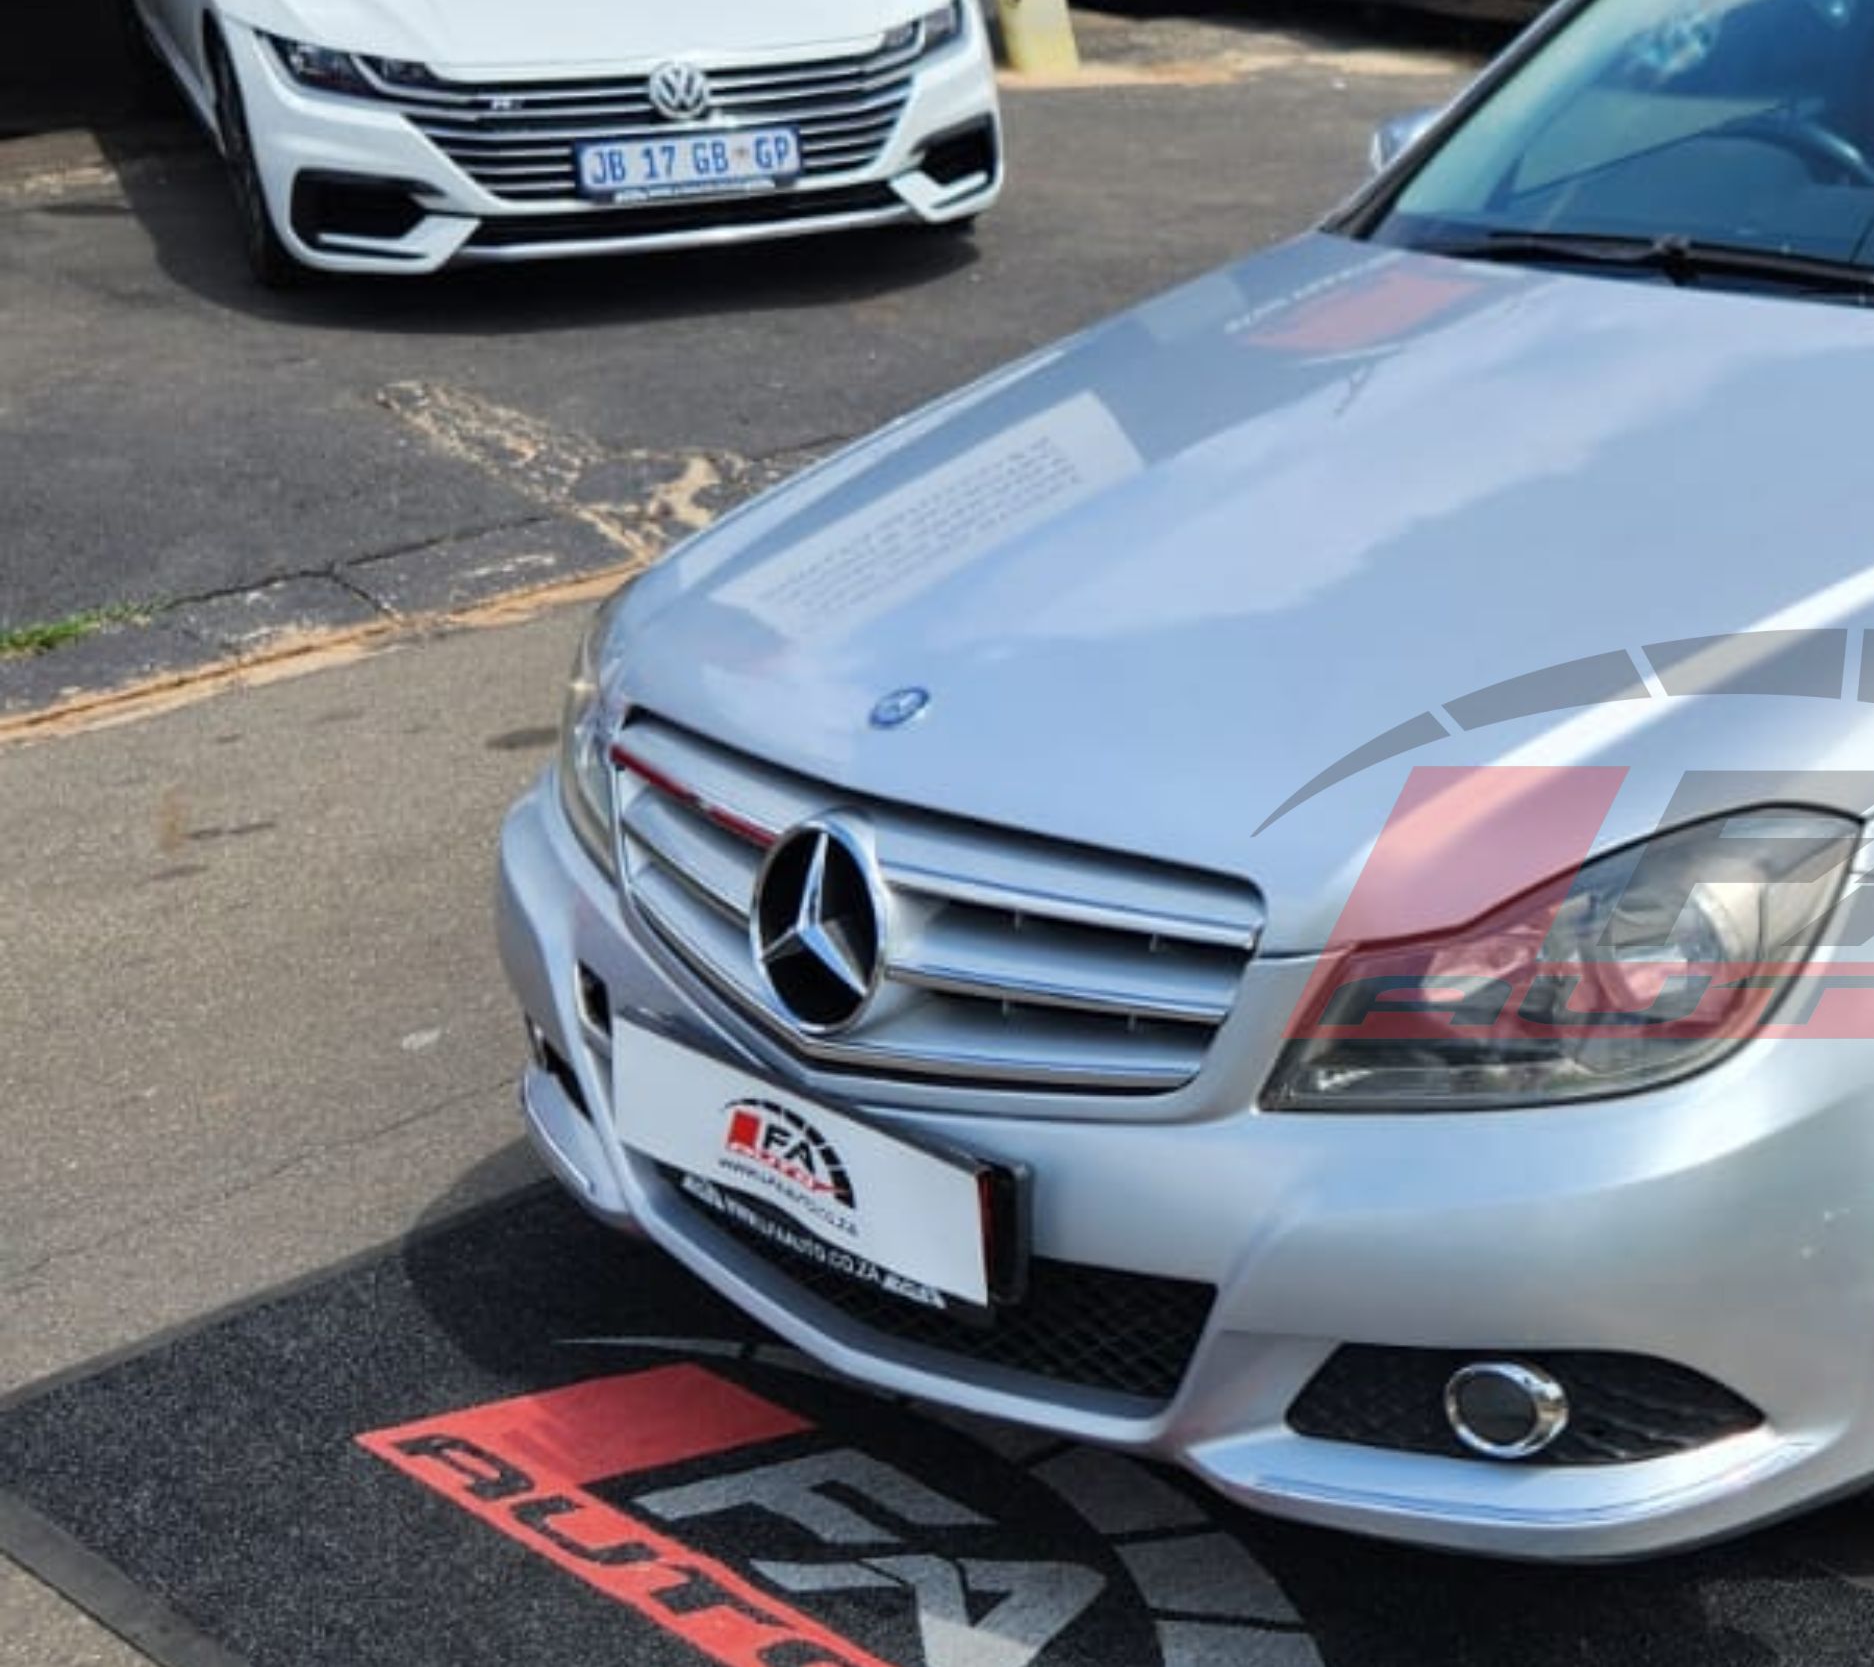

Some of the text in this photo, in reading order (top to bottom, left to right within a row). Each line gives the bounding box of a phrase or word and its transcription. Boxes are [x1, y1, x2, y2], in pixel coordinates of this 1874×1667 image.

[591, 135, 790, 185] JB 17 GB GP
